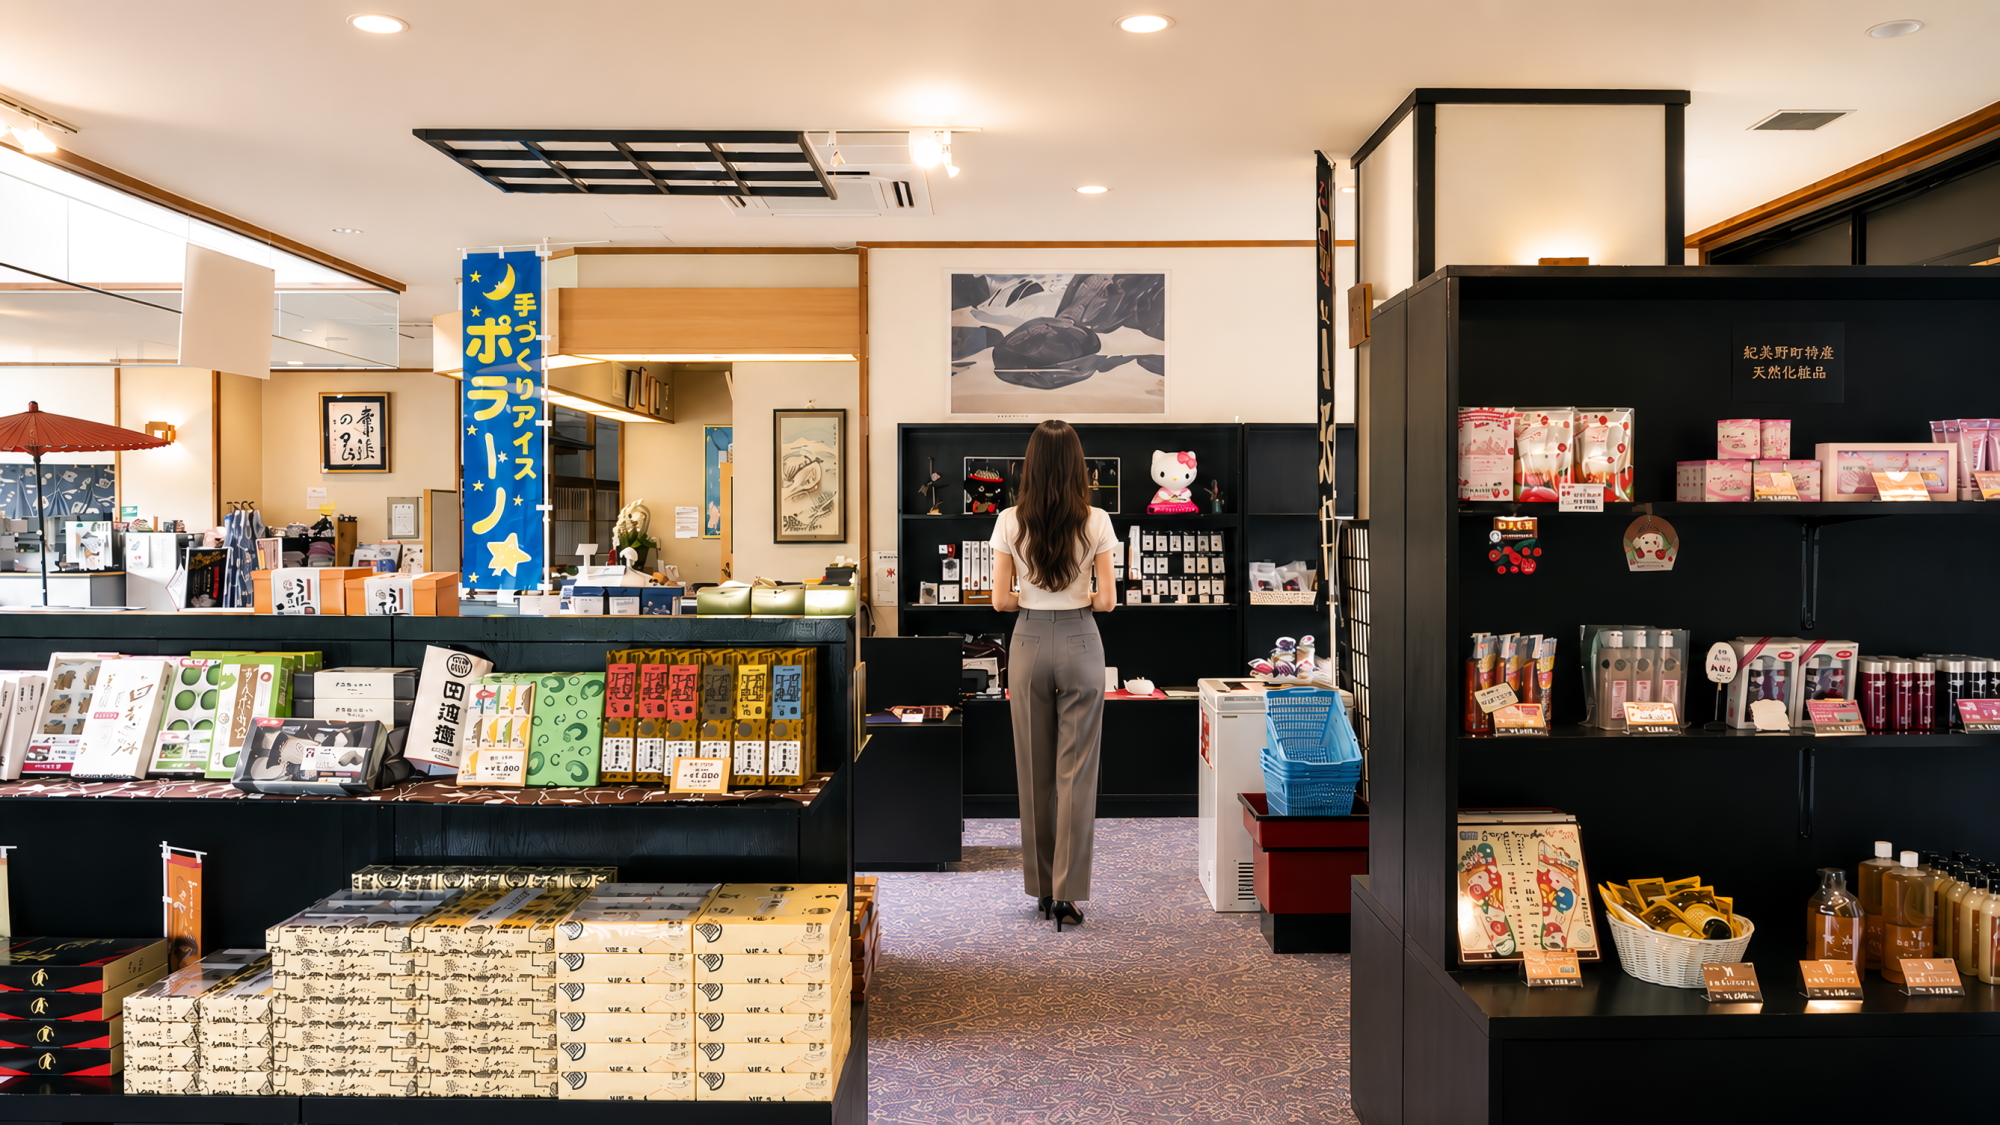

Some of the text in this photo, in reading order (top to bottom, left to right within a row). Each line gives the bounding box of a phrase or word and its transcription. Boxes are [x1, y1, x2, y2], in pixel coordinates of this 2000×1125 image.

[513, 292, 537, 481] 手づくりアイス
[1743, 345, 1835, 360] 紀美野町特産
[1752, 365, 1827, 379] 天然化粧品
[466, 314, 513, 534] ポラーノ
